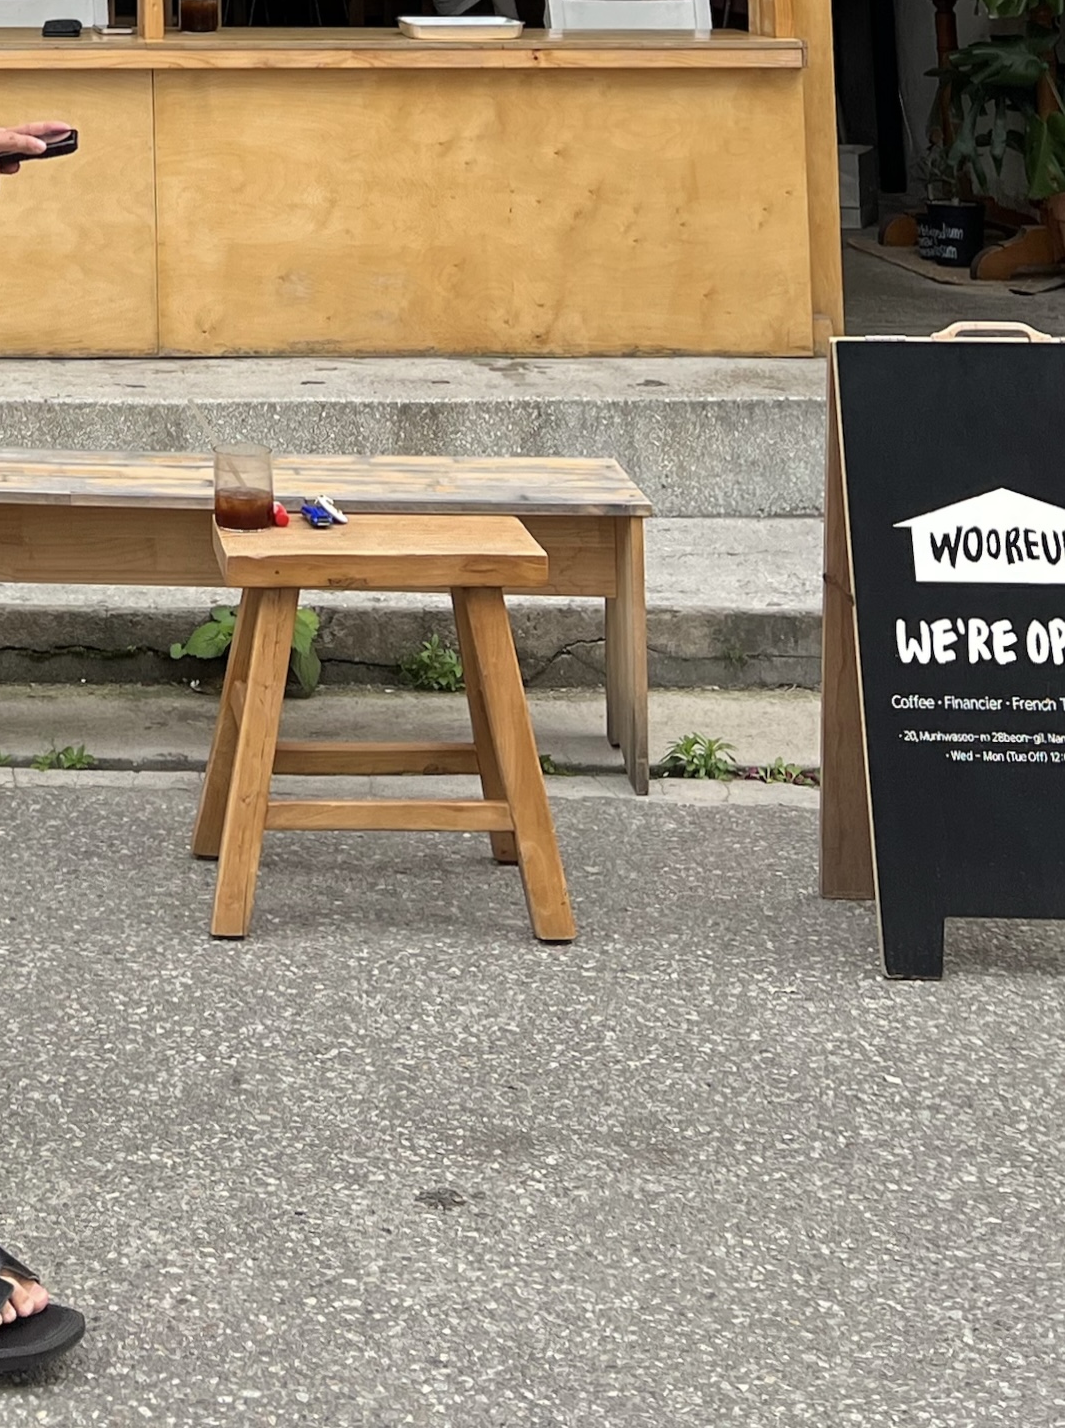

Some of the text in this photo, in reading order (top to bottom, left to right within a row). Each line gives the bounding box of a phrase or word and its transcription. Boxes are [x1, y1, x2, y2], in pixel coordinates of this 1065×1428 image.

[930, 526, 1065, 569] WOOREU
[896, 617, 1018, 665] WE'RE
[891, 694, 935, 709] Coffee
[944, 695, 1003, 710] Financier
[1012, 696, 1057, 711] French
[950, 750, 974, 762] Wed
[983, 751, 1005, 762] Mon
